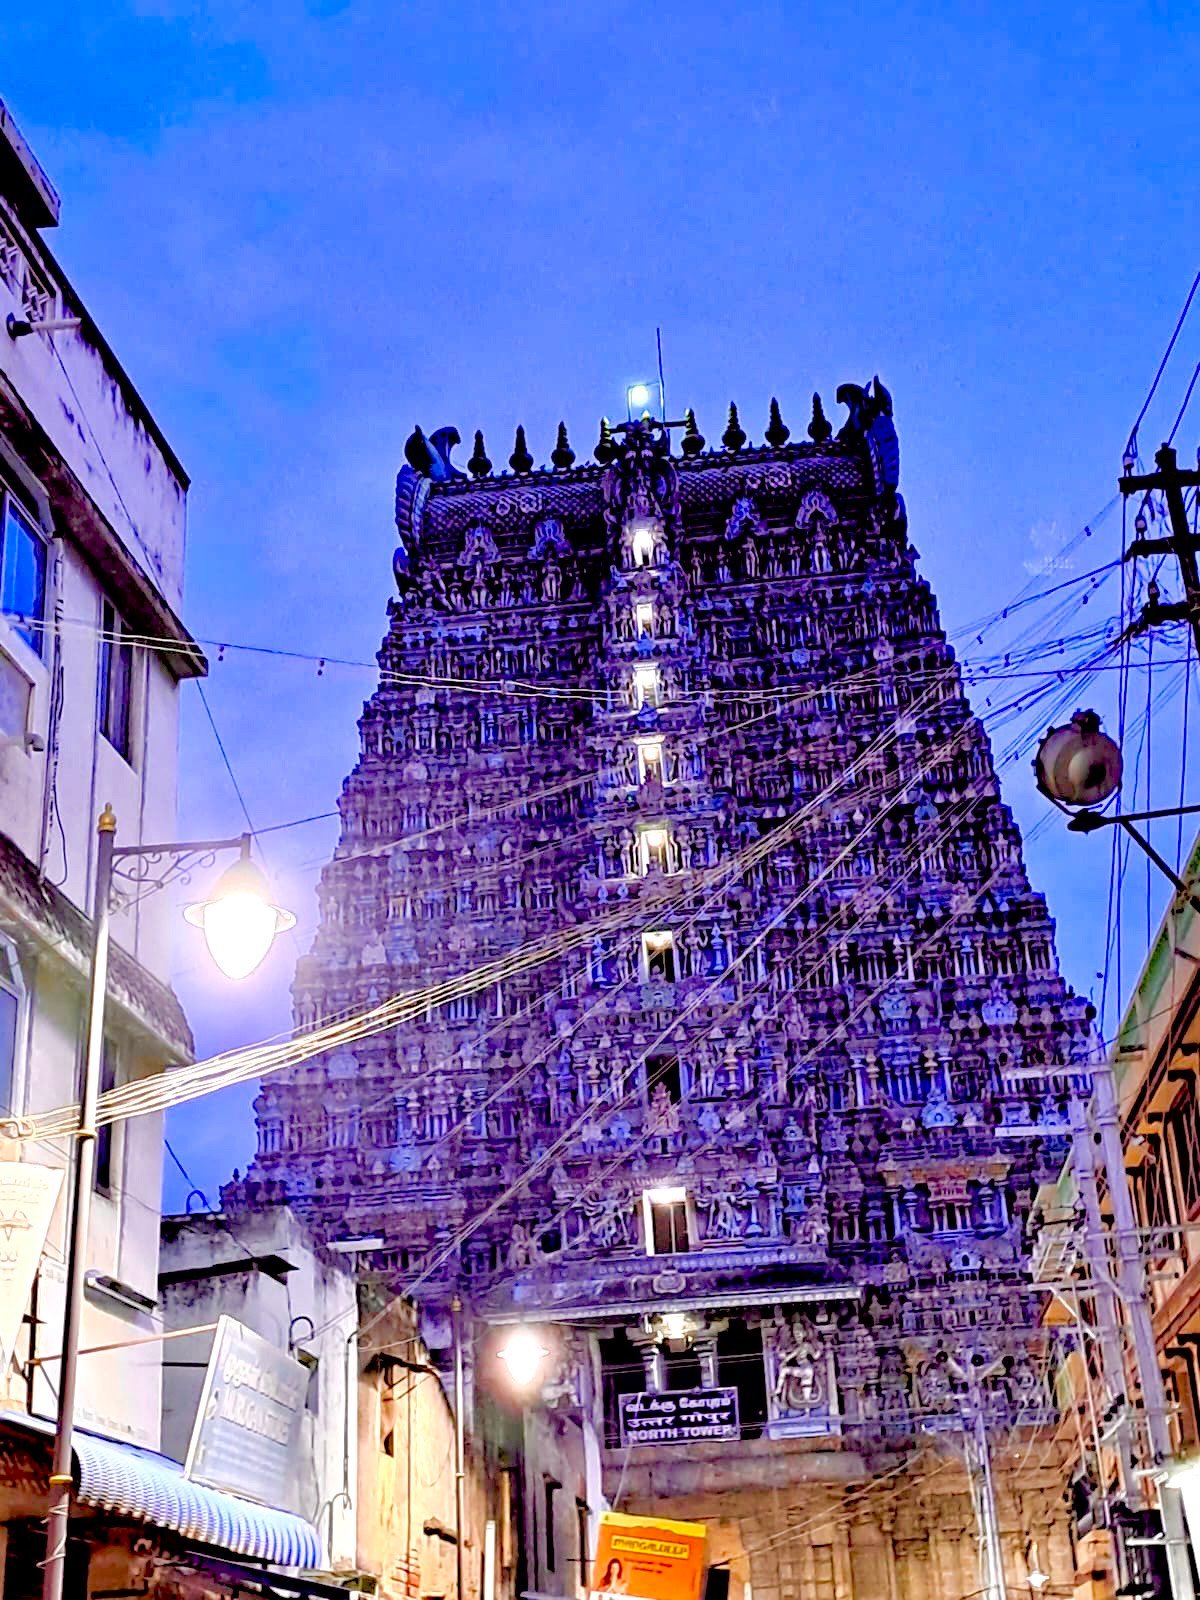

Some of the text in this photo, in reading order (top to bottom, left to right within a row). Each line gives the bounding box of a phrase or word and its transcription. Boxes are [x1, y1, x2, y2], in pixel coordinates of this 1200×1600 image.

[626, 1411, 732, 1428] उत्तर गोपुर
[626, 1424, 733, 1441] NORTH TOWER
